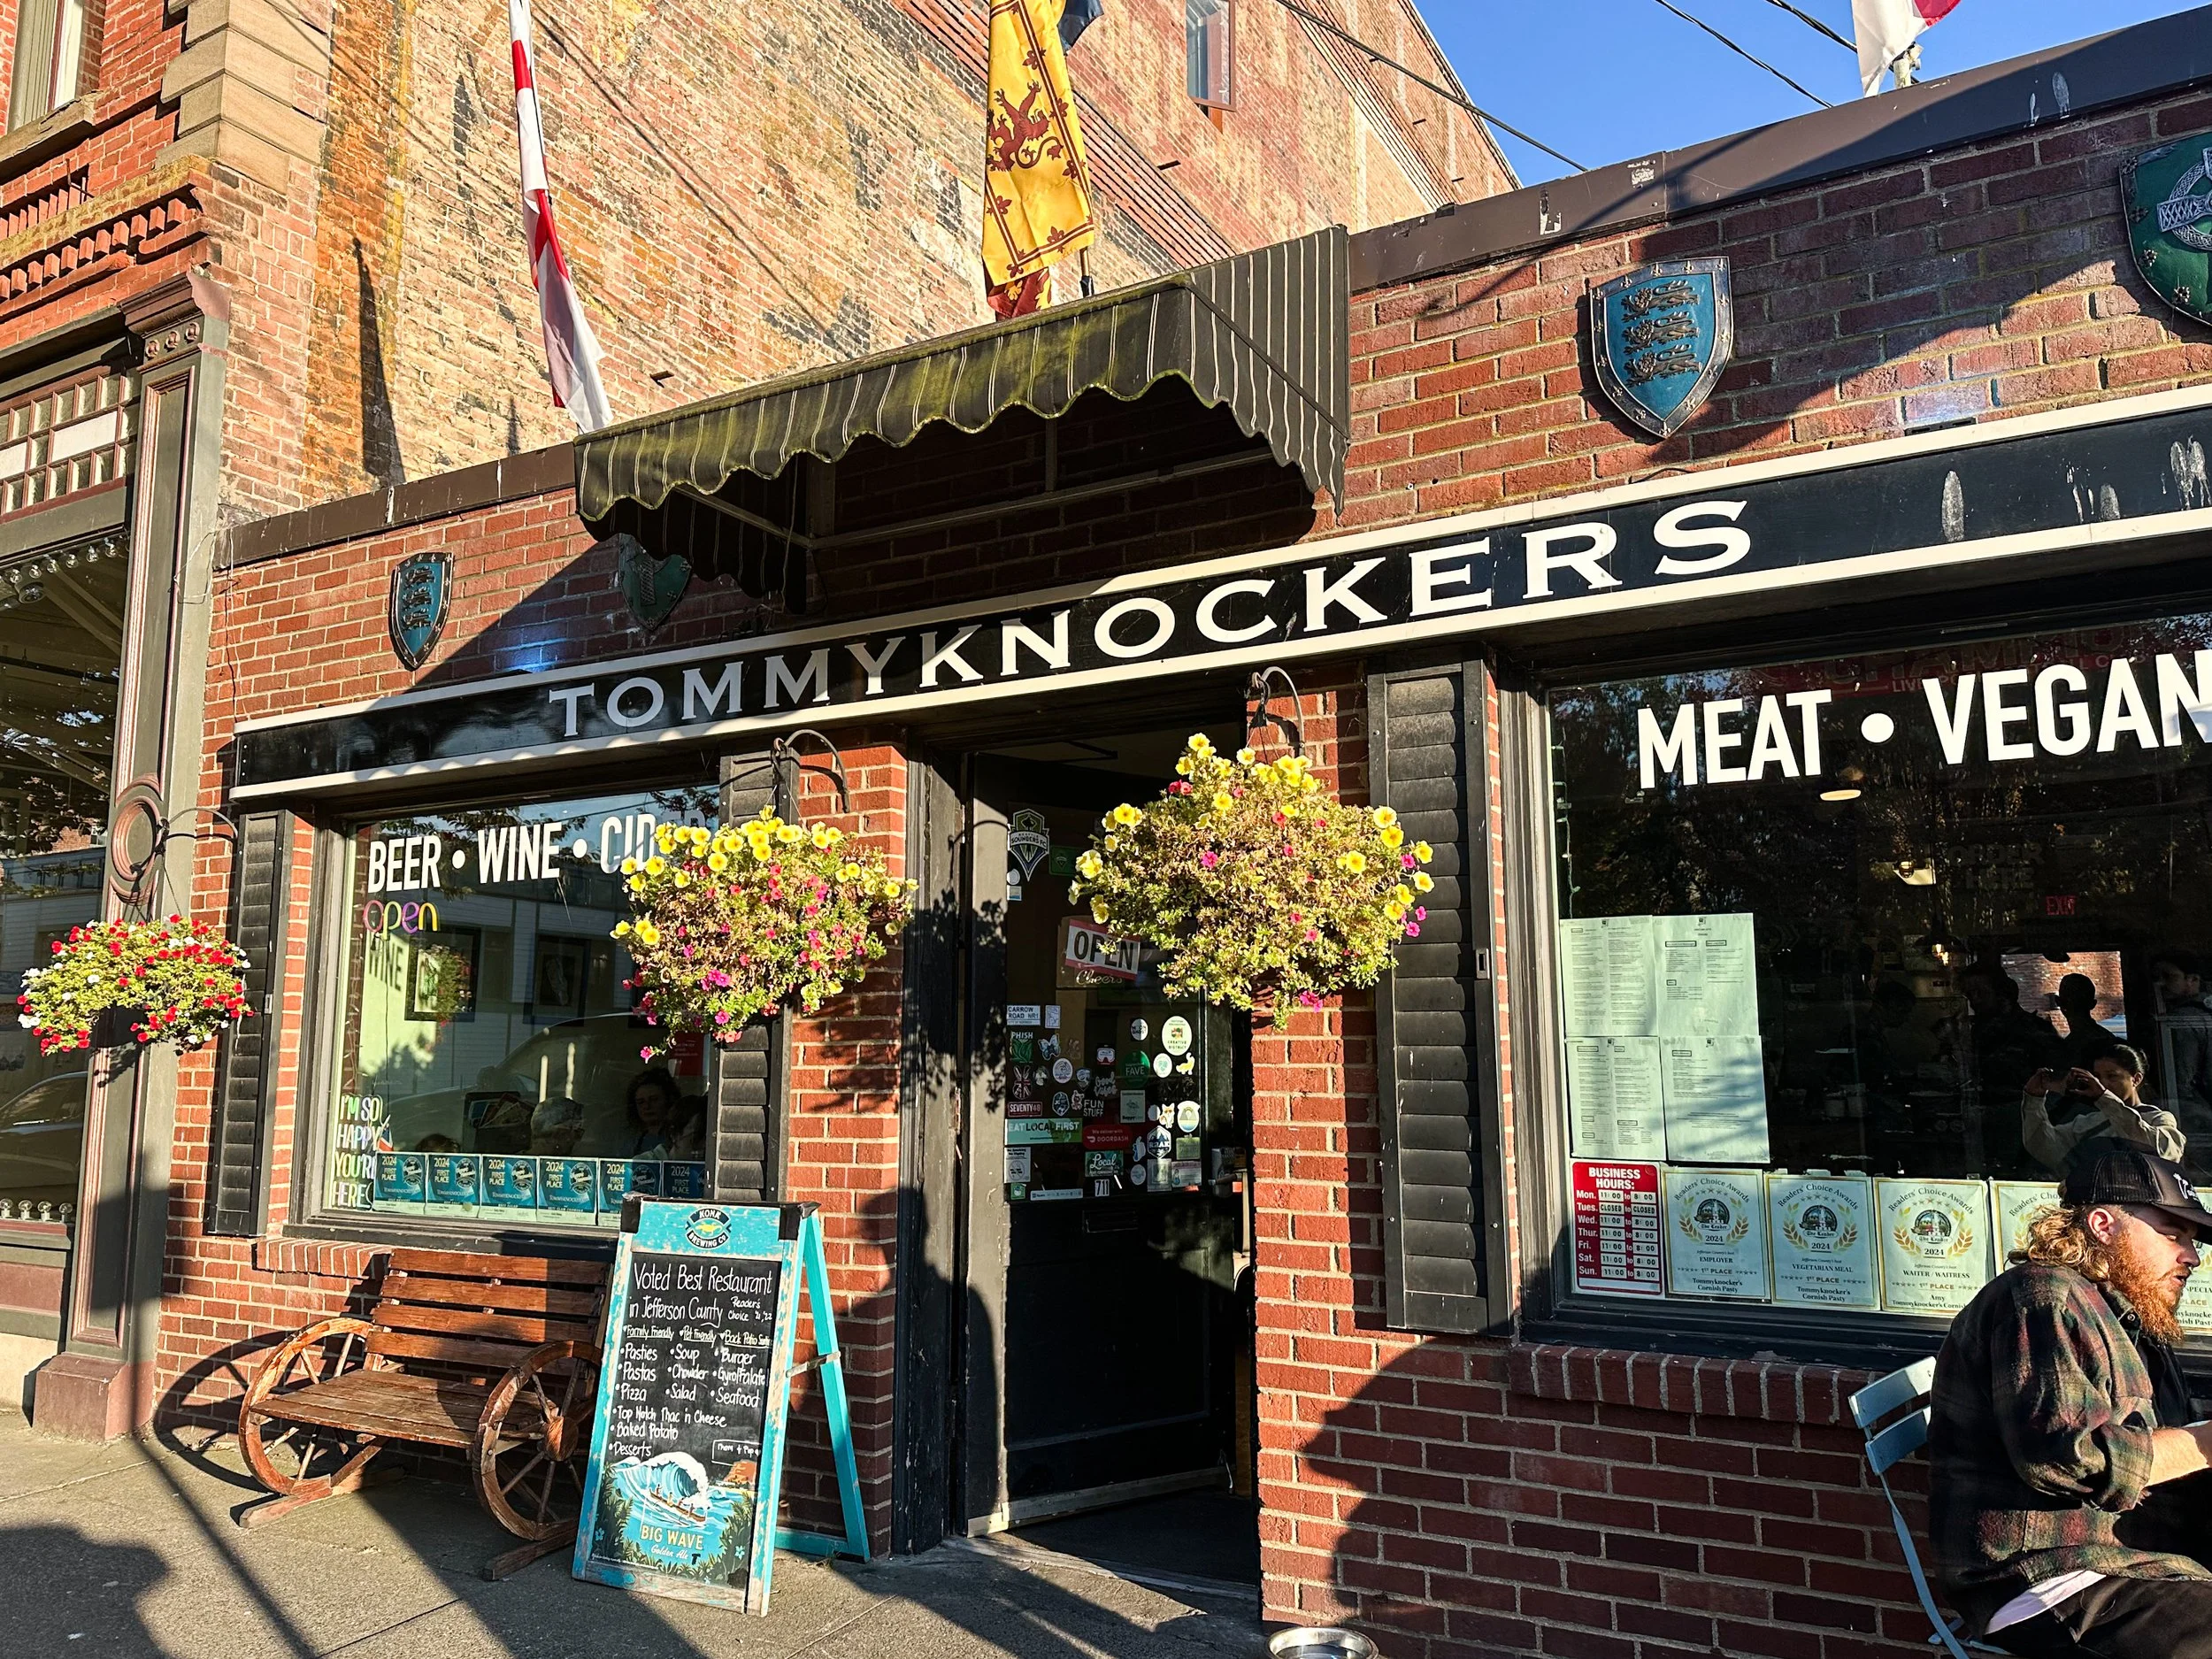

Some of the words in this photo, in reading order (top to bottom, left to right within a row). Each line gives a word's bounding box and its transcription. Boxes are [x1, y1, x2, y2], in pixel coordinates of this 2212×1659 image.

[549, 500, 1752, 737] TOMMYKNOCKERS
[1637, 689, 1832, 790] MEAT
[1923, 649, 2212, 765] VEGAN
[367, 835, 442, 893] BEER
[478, 822, 562, 884] WINE
[2046, 895, 2078, 916] EXIT
[1076, 969, 1123, 985] Cheers
[1125, 1066, 1145, 1076] FAVE
[340, 1095, 360, 1121] I'M
[361, 1097, 380, 1122] SO
[1009, 1123, 1026, 1132] EAT
[1026, 1123, 1054, 1132] LOCAL
[336, 1123, 381, 1151] HAPPY
[381, 1156, 396, 1166] 2024
[434, 1158, 449, 1167] 2024
[488, 1160, 505, 1169] 2024
[546, 1162, 564, 1171] 2024
[606, 1164, 625, 1174] 2024
[1089, 1153, 1116, 1169] Local
[671, 1166, 690, 1177] 2024
[1588, 1167, 1640, 1179] BUSINESS
[1595, 1179, 1635, 1189] HOURS:
[1673, 1179, 1698, 1201] Readers'
[1726, 1183, 1749, 1203] Awards
[331, 1180, 371, 1209] HERE
[1576, 1190, 1596, 1199] Mon.
[1778, 1186, 1803, 1207] Readers'
[1806, 1183, 1832, 1193] Choice
[1833, 1189, 1858, 1210] Awards
[1888, 1189, 1916, 1211] Readers'
[1918, 1187, 1947, 1196] Choice
[1947, 1194, 1974, 1214] Awards
[1577, 1202, 1598, 1211] Tues.
[2008, 1194, 2038, 1217] Readers'
[699, 1210, 721, 1219] KONA
[1578, 1215, 1597, 1224] Wed.
[1578, 1227, 1598, 1237] Thur.
[688, 1233, 717, 1248] BREWING
[1578, 1253, 1594, 1262] Sat.
[634, 1263, 671, 1291] Voted
[677, 1264, 703, 1291] Best
[708, 1265, 772, 1294] Restaurant
[1578, 1266, 1597, 1275] Sun.
[1797, 1286, 1850, 1295] Tommyknocker's
[629, 1296, 639, 1317] in
[641, 1296, 686, 1321] Jefferson
[688, 1296, 723, 1327] County
[1893, 1299, 1941, 1309] Tommyknocker's
[728, 1310, 749, 1321] Choice
[627, 1325, 649, 1340] Family
[651, 1325, 674, 1341] Friendly
[683, 1325, 694, 1340] Pet
[694, 1328, 717, 1348] Friendly
[725, 1329, 741, 1344] Back
[743, 1332, 758, 1345] Patio
[625, 1342, 657, 1361] Pasties
[674, 1343, 699, 1365] Soup
[720, 1346, 757, 1369] Burger
[623, 1362, 657, 1381] Pastas
[672, 1363, 709, 1380] Chowder
[621, 1383, 646, 1402] Pizza
[670, 1383, 696, 1402] Salad
[716, 1387, 760, 1408] Seafood
[617, 1406, 633, 1423] Top
[635, 1406, 656, 1422] Notch
[661, 1407, 680, 1423] Mac
[694, 1409, 727, 1427] Cheese
[617, 1421, 646, 1438] Baked
[649, 1422, 679, 1440] Potato
[614, 1440, 652, 1457] Desserts
[640, 1525, 663, 1542] BIG
[667, 1530, 703, 1550] WAVE
[651, 1545, 673, 1557] Golden
[676, 1549, 688, 1560] Ale
